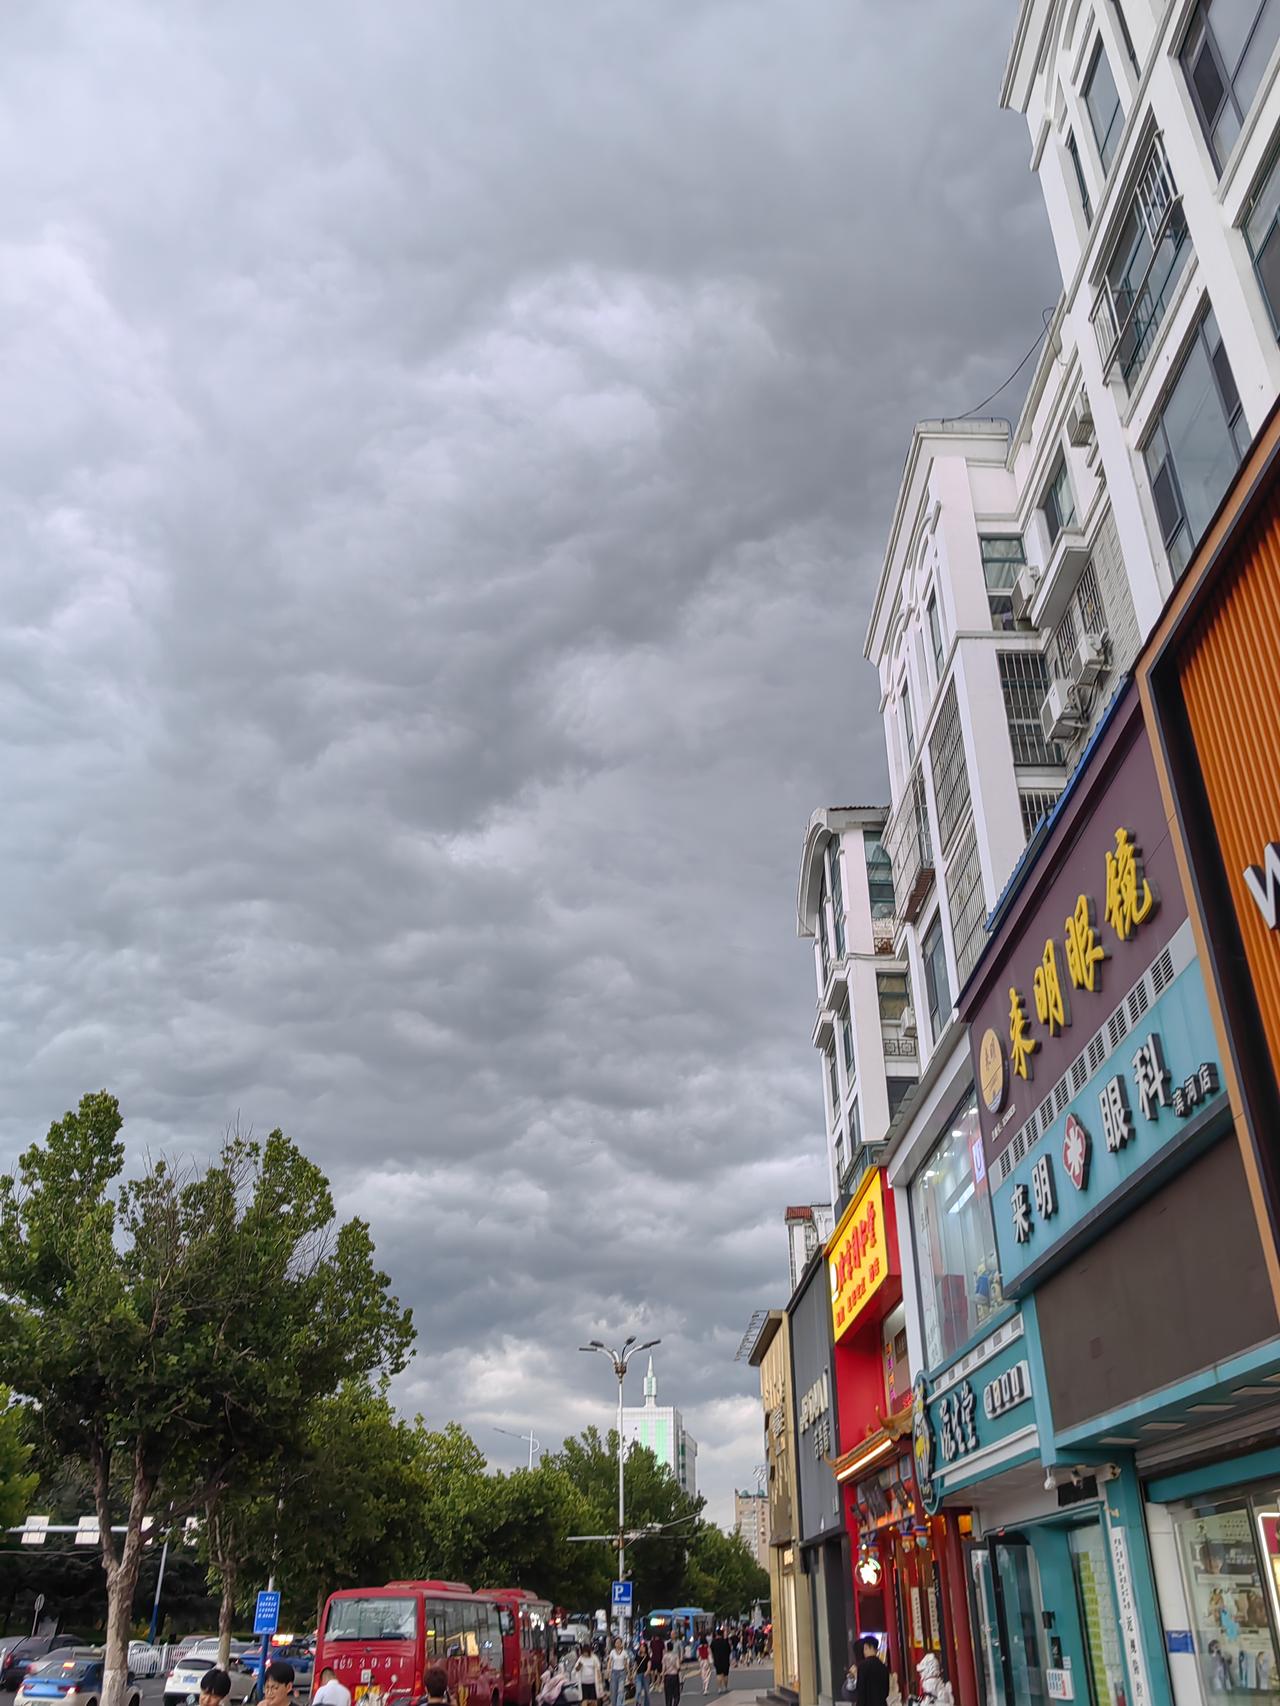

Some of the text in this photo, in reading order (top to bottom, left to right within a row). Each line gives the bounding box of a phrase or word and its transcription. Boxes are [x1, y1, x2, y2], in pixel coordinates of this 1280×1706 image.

[1009, 827, 1153, 1080] 来明眼镜
[1098, 1034, 1169, 1153] 眼科
[614, 1584, 624, 1601] P
